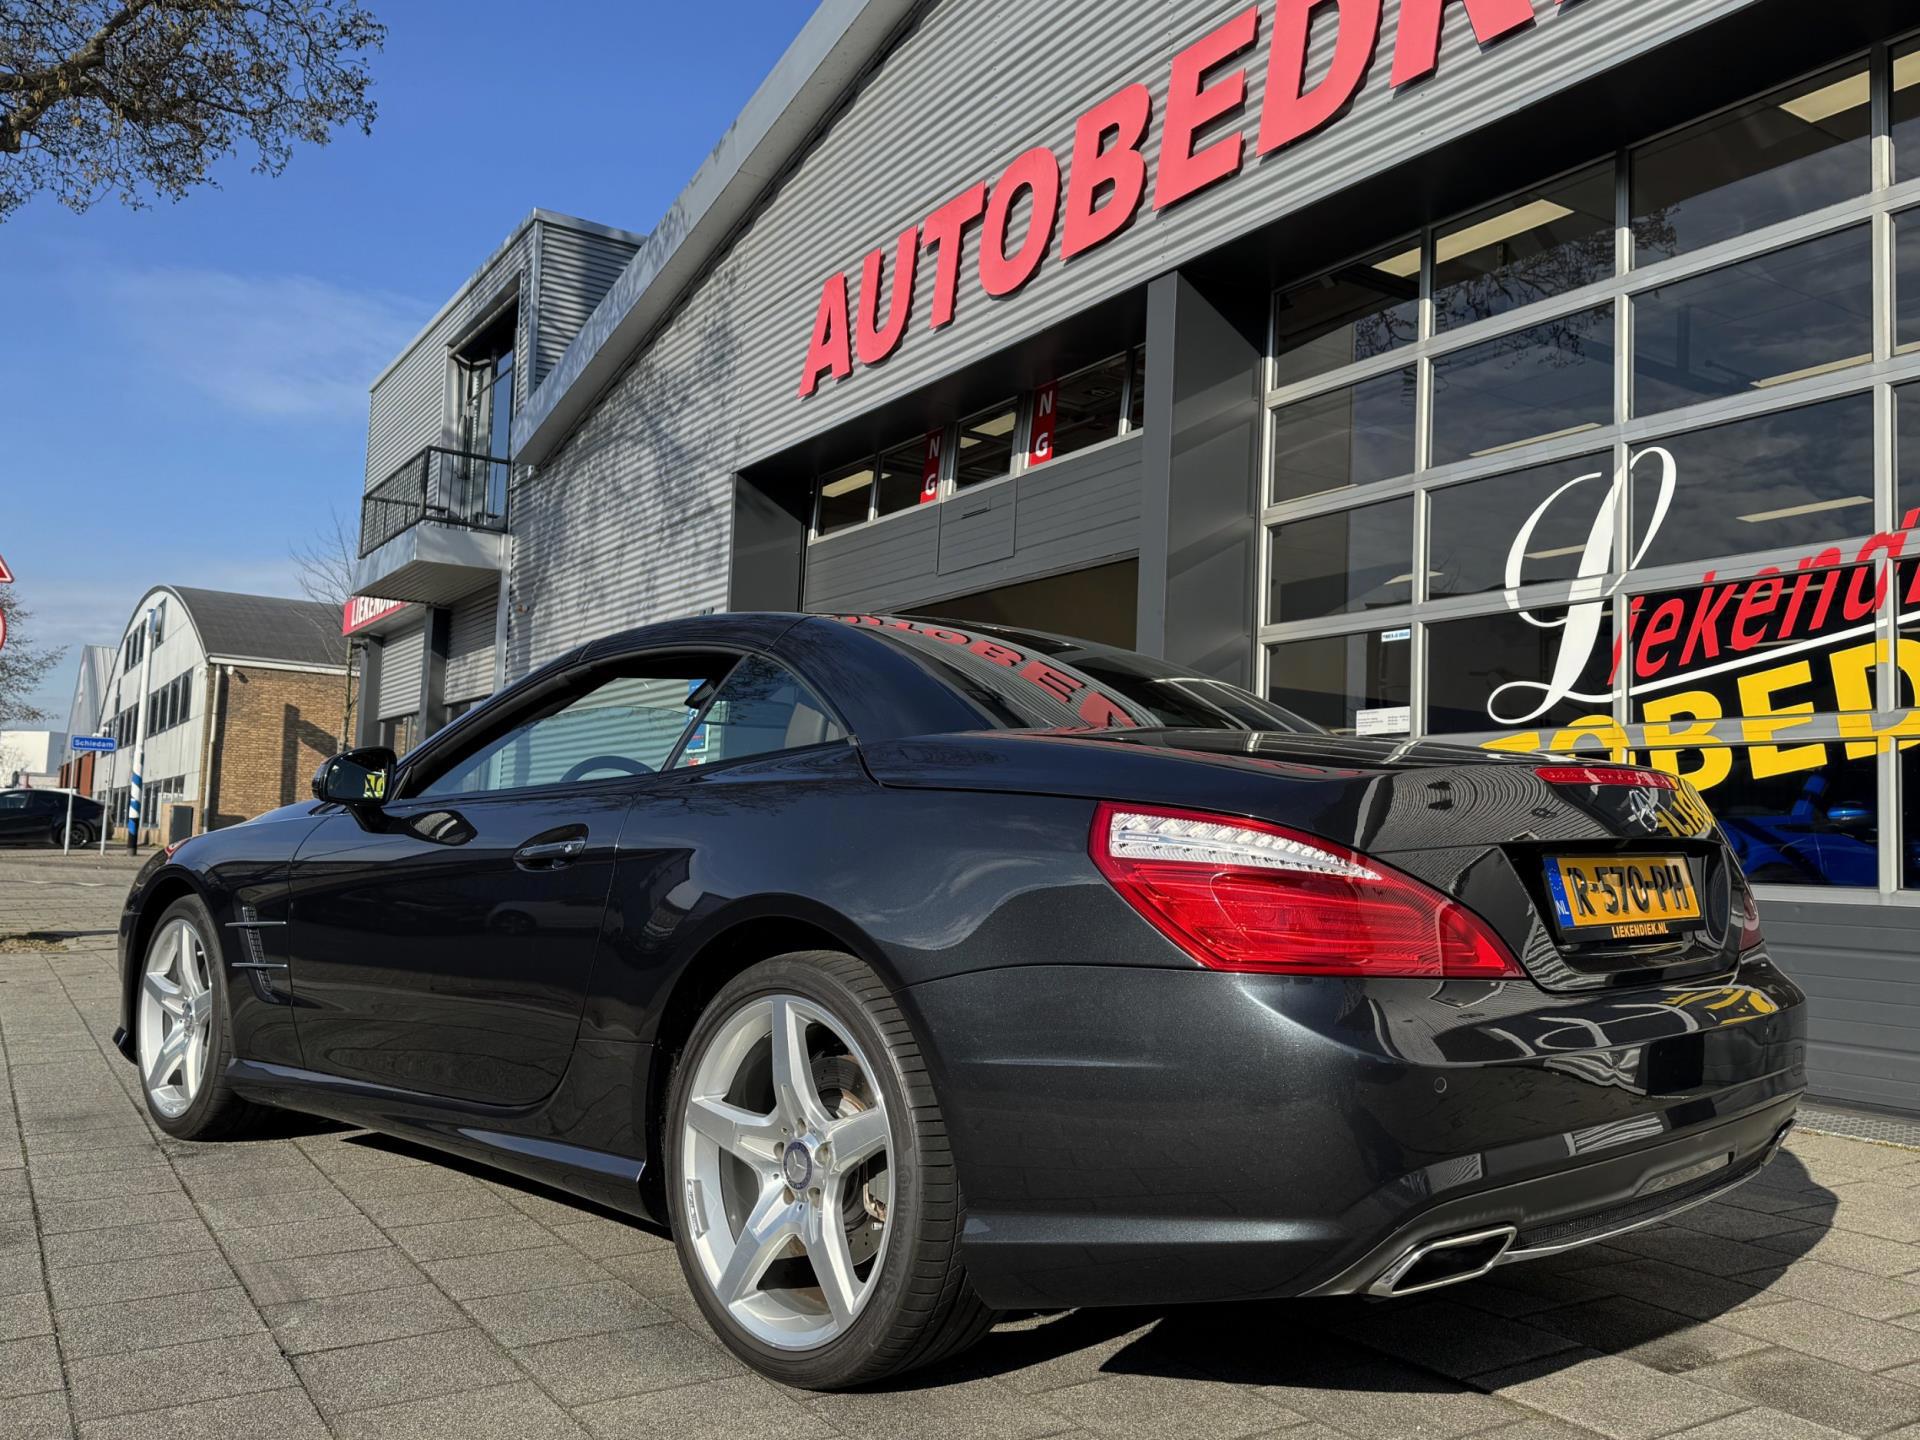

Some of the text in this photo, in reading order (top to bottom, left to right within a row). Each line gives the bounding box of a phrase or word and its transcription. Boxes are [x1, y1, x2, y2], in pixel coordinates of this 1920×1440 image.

[73, 739, 114, 749] Schiedam
[1566, 865, 1689, 916] R-570-PH
[1555, 901, 1570, 915] NL
[1611, 922, 1669, 938] LIEKENDIEK.NL
